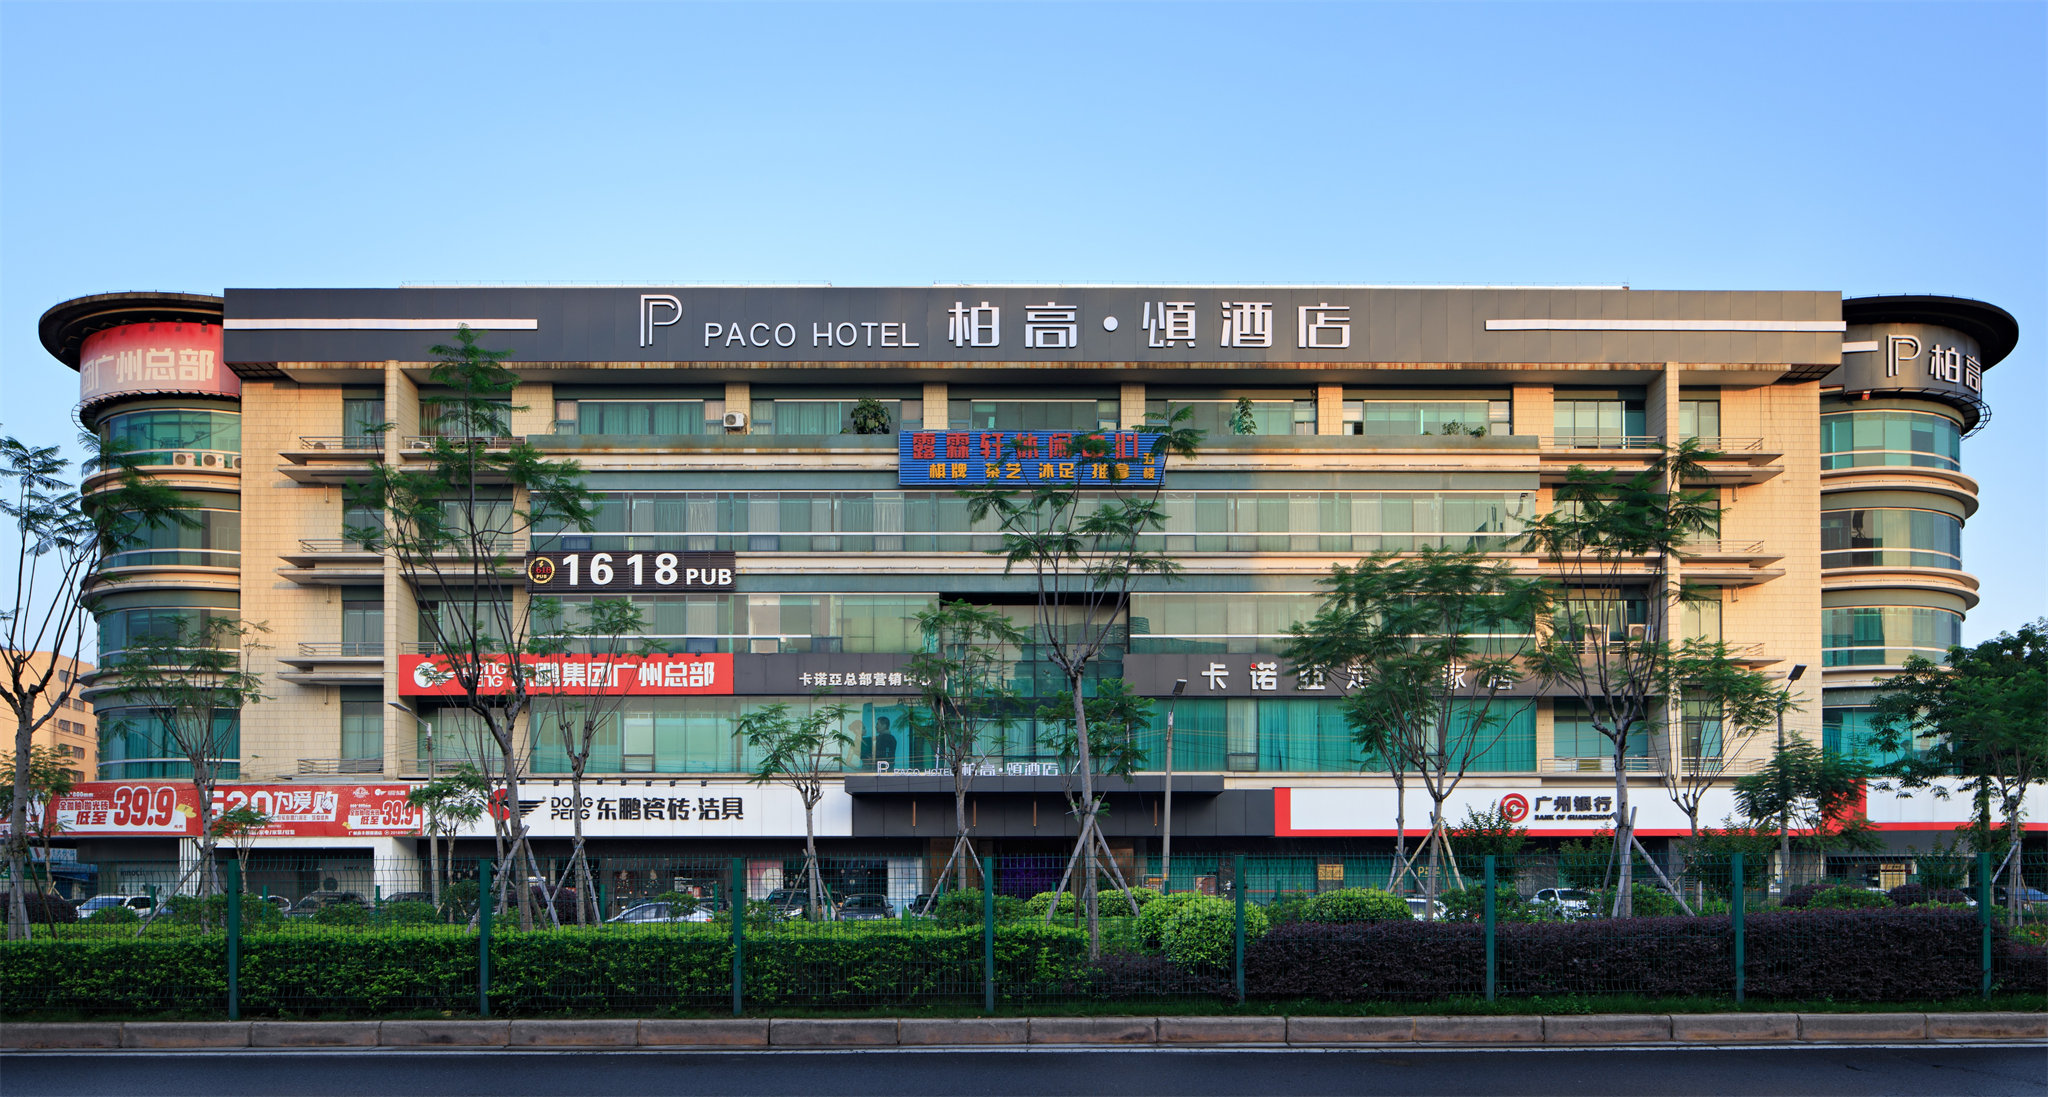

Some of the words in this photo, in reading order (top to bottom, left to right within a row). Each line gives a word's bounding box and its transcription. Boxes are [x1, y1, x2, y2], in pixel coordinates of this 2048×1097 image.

[704, 322, 796, 347] PACO
[813, 322, 920, 347] HOTEL
[532, 566, 552, 574] 618
[686, 568, 732, 586] PUB
[113, 785, 177, 827] 39.9
[597, 797, 744, 820] 东鹏瓷砖·洁具
[1535, 796, 1613, 812] 广州银行
[76, 810, 108, 825] 低至
